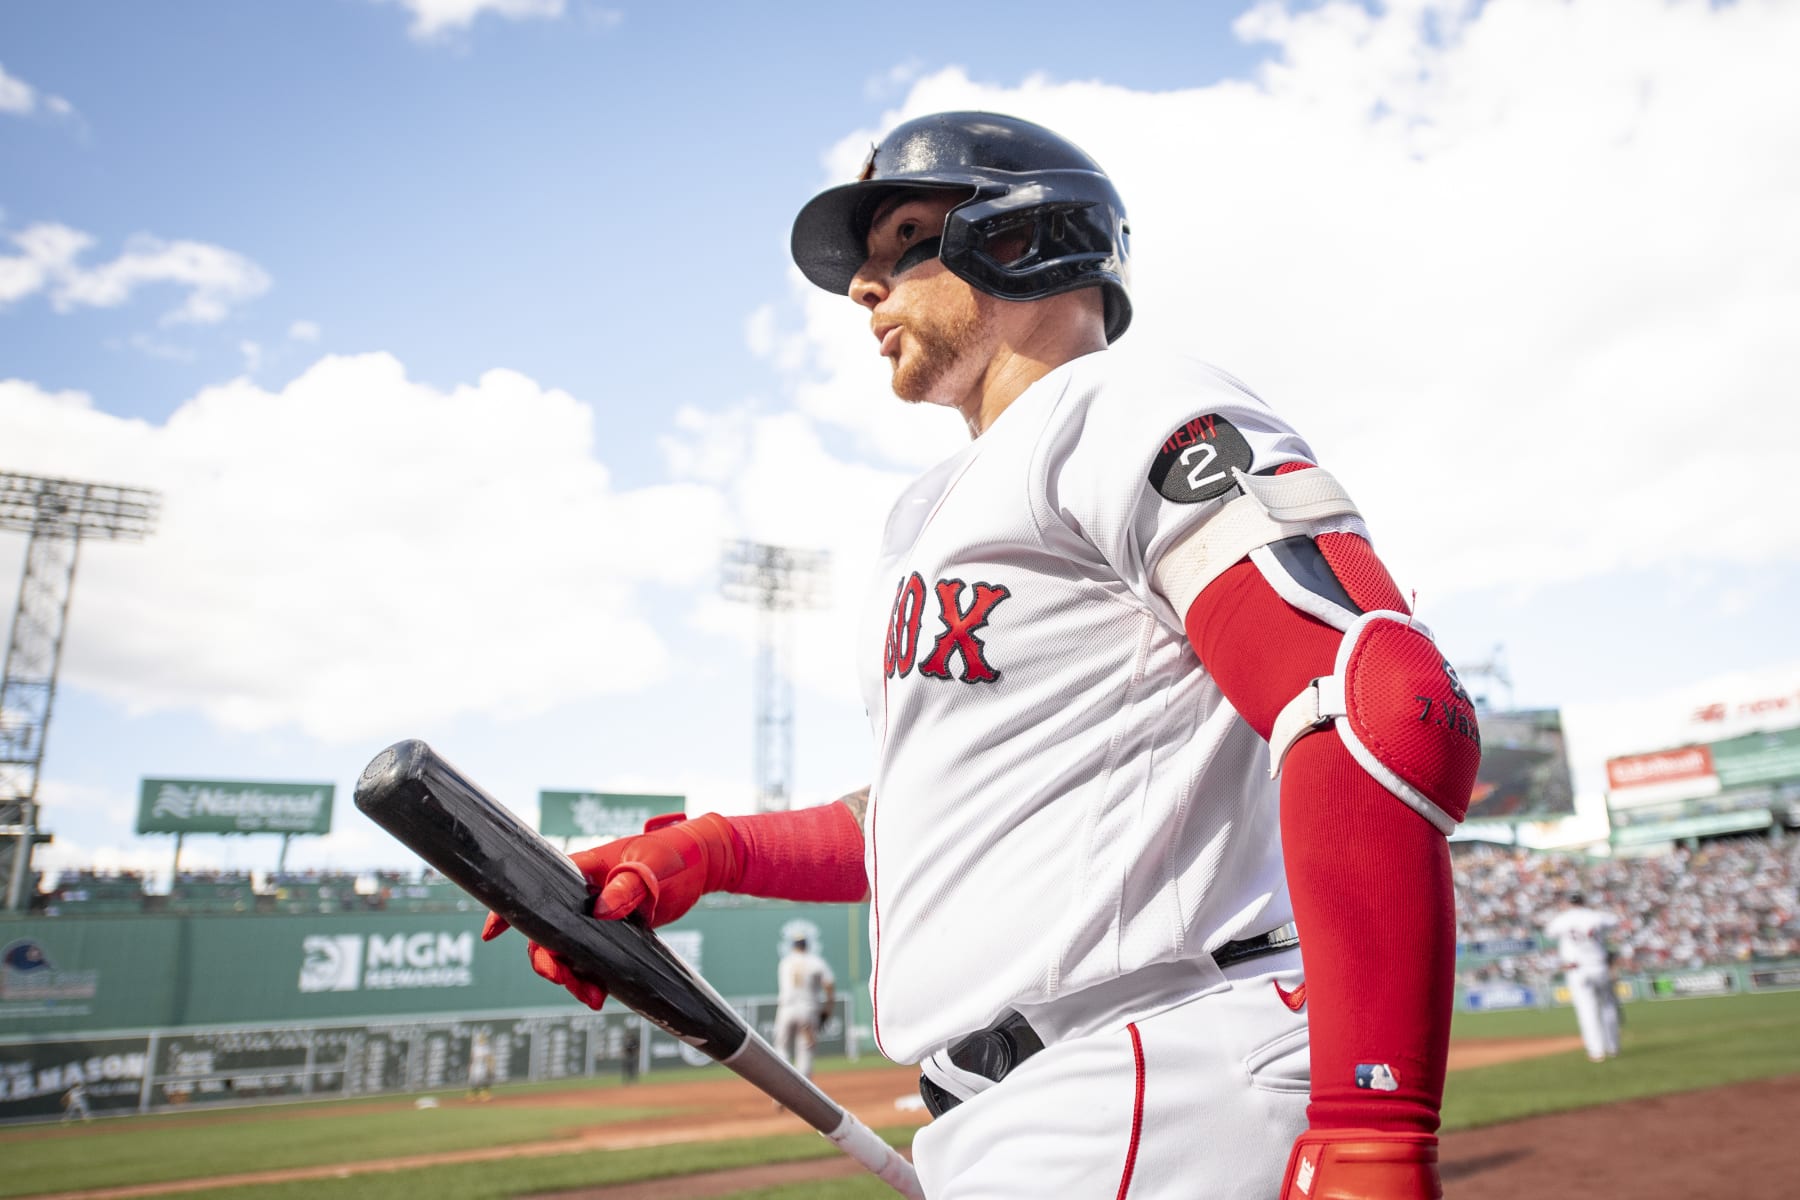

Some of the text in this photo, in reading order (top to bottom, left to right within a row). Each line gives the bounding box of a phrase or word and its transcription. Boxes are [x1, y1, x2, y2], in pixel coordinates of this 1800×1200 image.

[1179, 442, 1226, 490] 2
[194, 785, 322, 817] National
[367, 931, 474, 968] MGM
[37, 1052, 148, 1095] MASON
